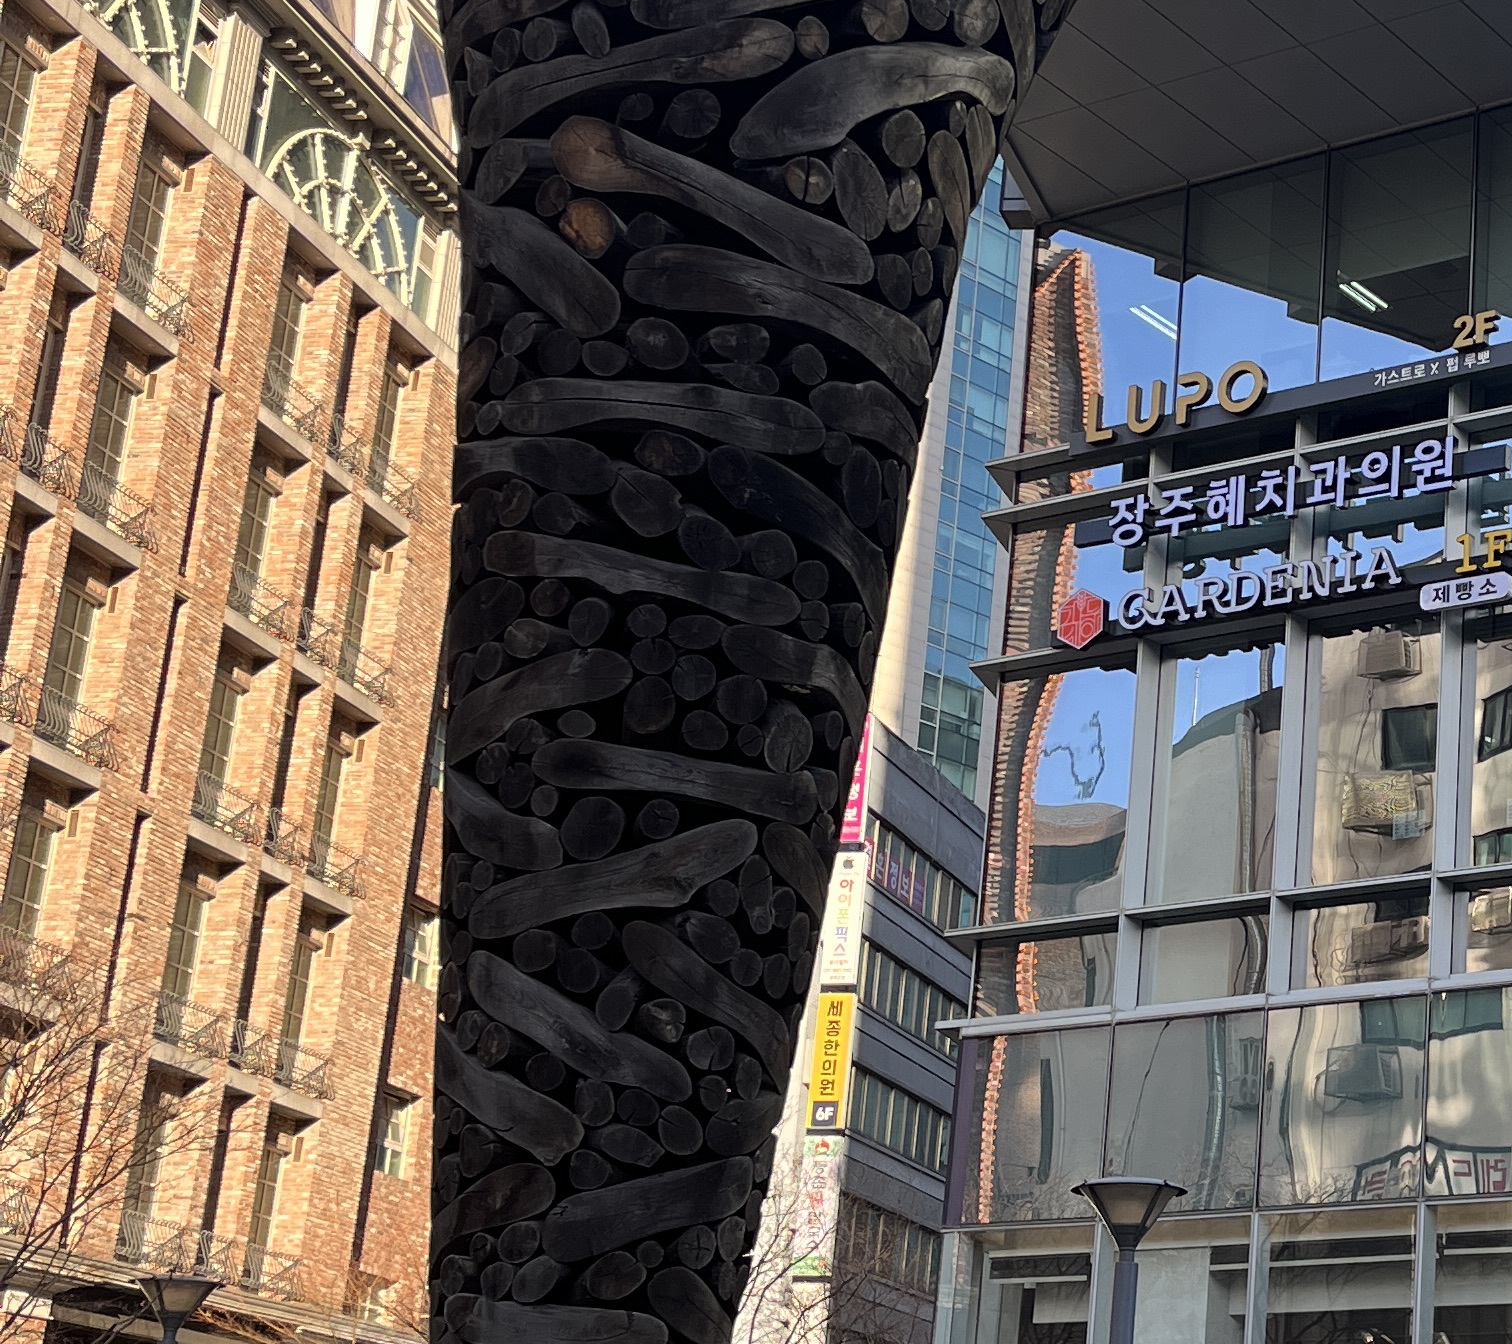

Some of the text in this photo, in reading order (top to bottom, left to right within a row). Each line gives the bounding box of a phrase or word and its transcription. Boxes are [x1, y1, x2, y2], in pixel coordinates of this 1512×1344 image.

[1452, 309, 1501, 350] 2F
[1085, 360, 1268, 444] LUPO
[1373, 363, 1426, 387] 가스트로
[1108, 435, 1456, 546] 장주혜치과의원
[1117, 545, 1403, 630] GARDENIA
[1431, 577, 1498, 604] 제빵소
[819, 999, 844, 1097] 세종한의원
[814, 1106, 836, 1121] 6F
